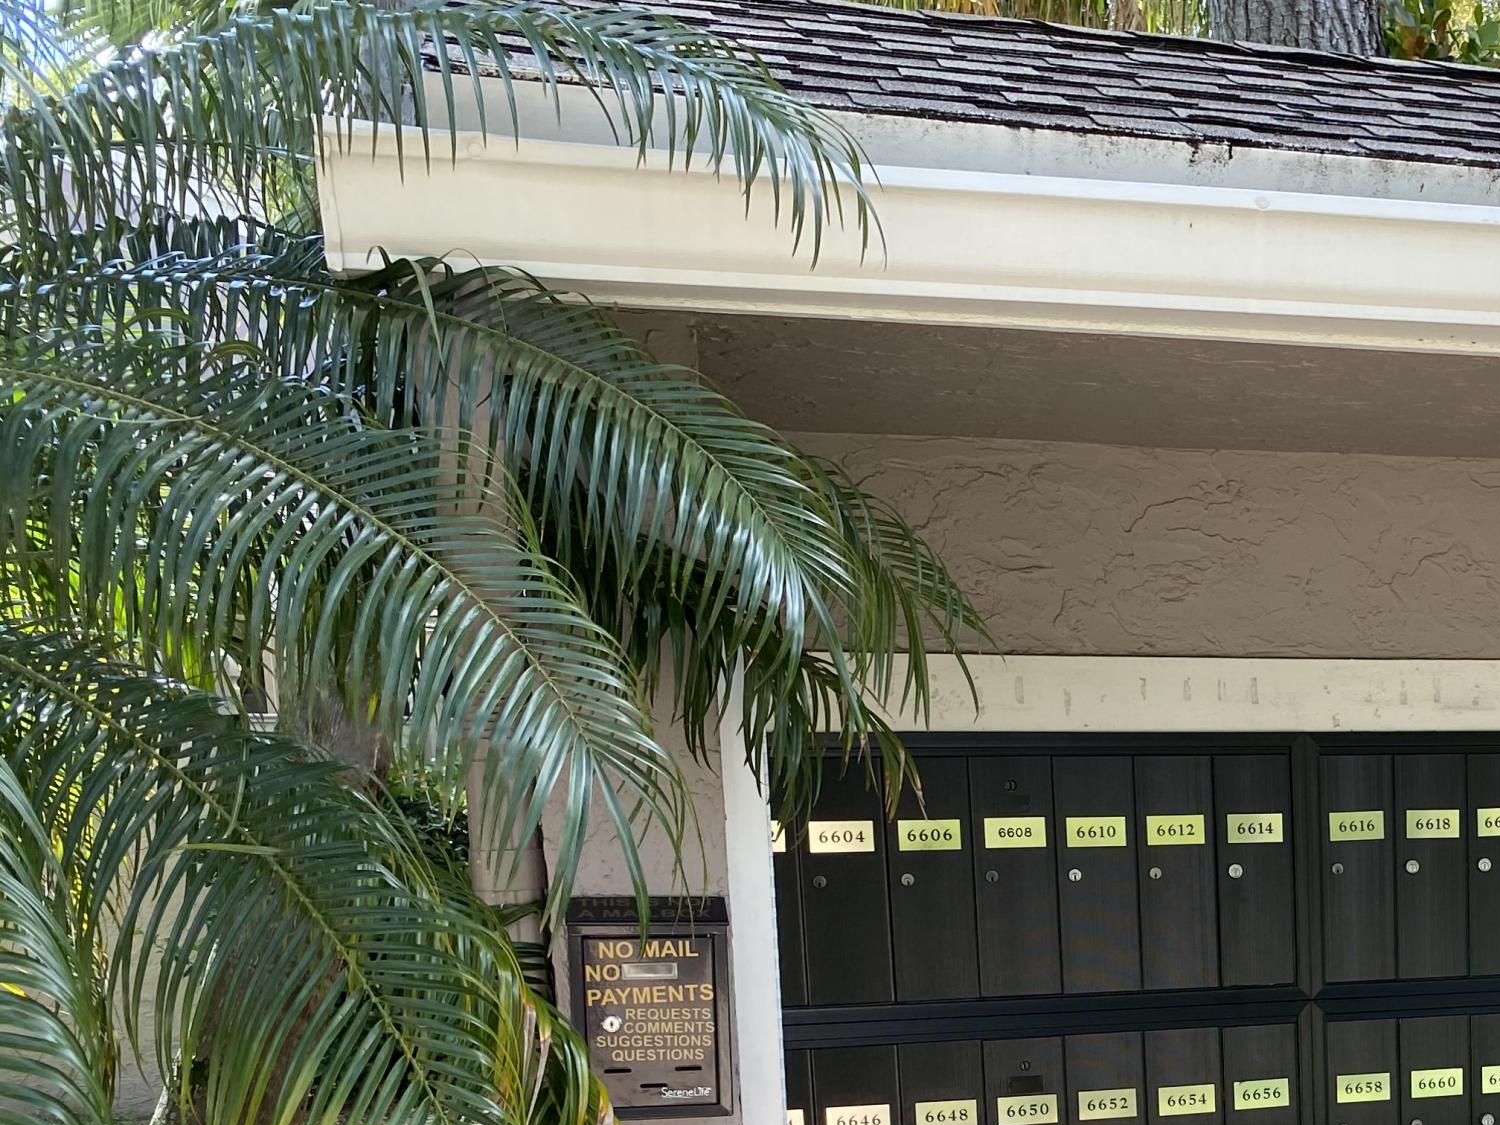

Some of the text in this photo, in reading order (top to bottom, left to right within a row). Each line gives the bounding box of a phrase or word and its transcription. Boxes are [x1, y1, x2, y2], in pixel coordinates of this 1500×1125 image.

[1156, 823, 1195, 837] 6612
[1237, 822, 1273, 835] 6614
[1338, 819, 1375, 833] 6616
[1415, 817, 1451, 831] 6618
[818, 830, 866, 844] 6604
[907, 828, 953, 842] 6606
[998, 827, 1033, 838] 6608
[1076, 825, 1117, 839] 6610
[577, 898, 629, 907] THIS
[577, 909, 711, 918] A MALBOX
[598, 940, 699, 959] NO MAIL
[585, 964, 620, 982] NO
[587, 984, 714, 1007] PAYMENTS
[625, 1008, 712, 1020] REQUESTS
[624, 1021, 715, 1034] COMMENTS
[596, 1035, 712, 1047] SUGGESTIONS
[612, 1049, 704, 1062] QUESTIONS
[1344, 1080, 1383, 1095] 6658
[1418, 1076, 1456, 1090] 6660
[661, 1086, 711, 1097] SereneLife
[1241, 1085, 1282, 1101] 6656
[1087, 1097, 1129, 1112] 6652
[1167, 1093, 1207, 1107] 6654
[925, 1108, 969, 1123] 6648
[1006, 1102, 1050, 1118] 6650
